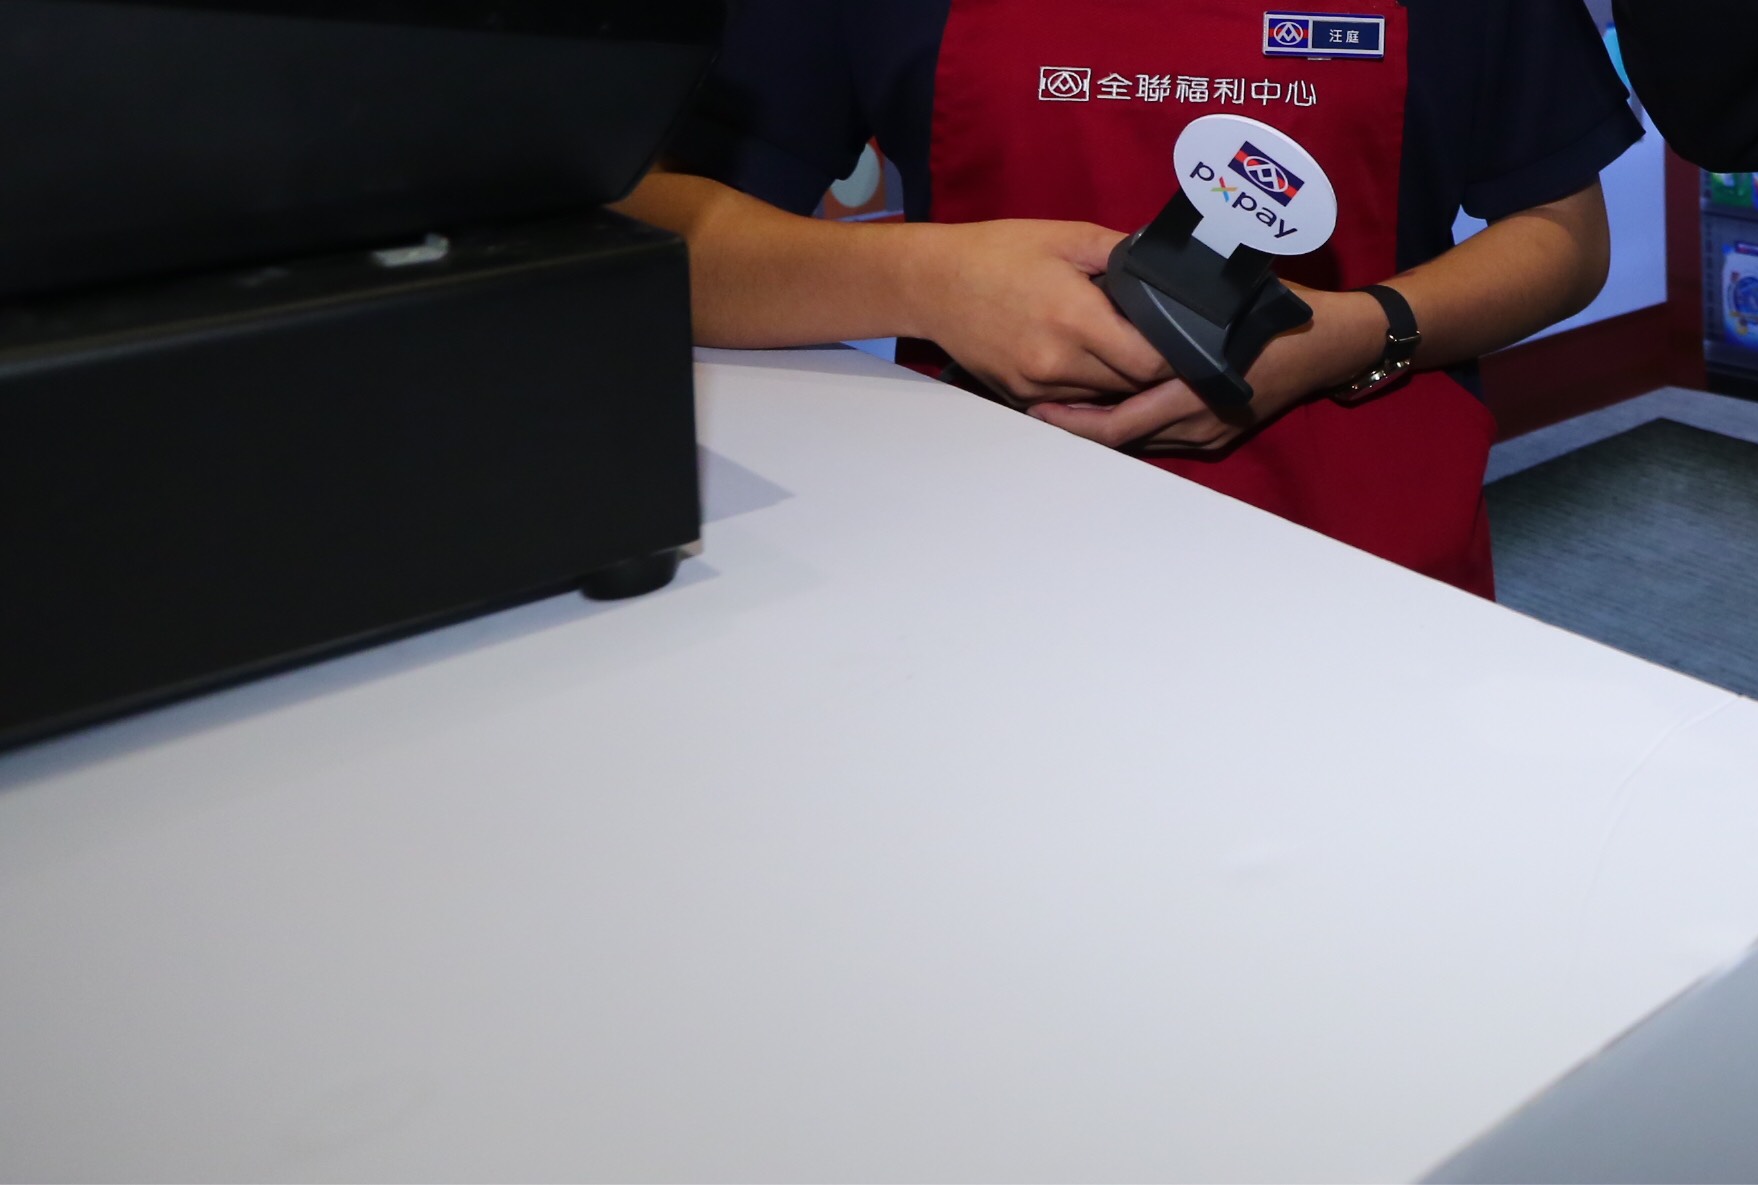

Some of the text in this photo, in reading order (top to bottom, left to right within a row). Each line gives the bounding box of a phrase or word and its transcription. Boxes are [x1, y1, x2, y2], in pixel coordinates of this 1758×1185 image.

[1329, 28, 1360, 44] 汪庭
[1097, 72, 1317, 107] 全聯福利中心
[1189, 161, 1298, 240] pxpay
